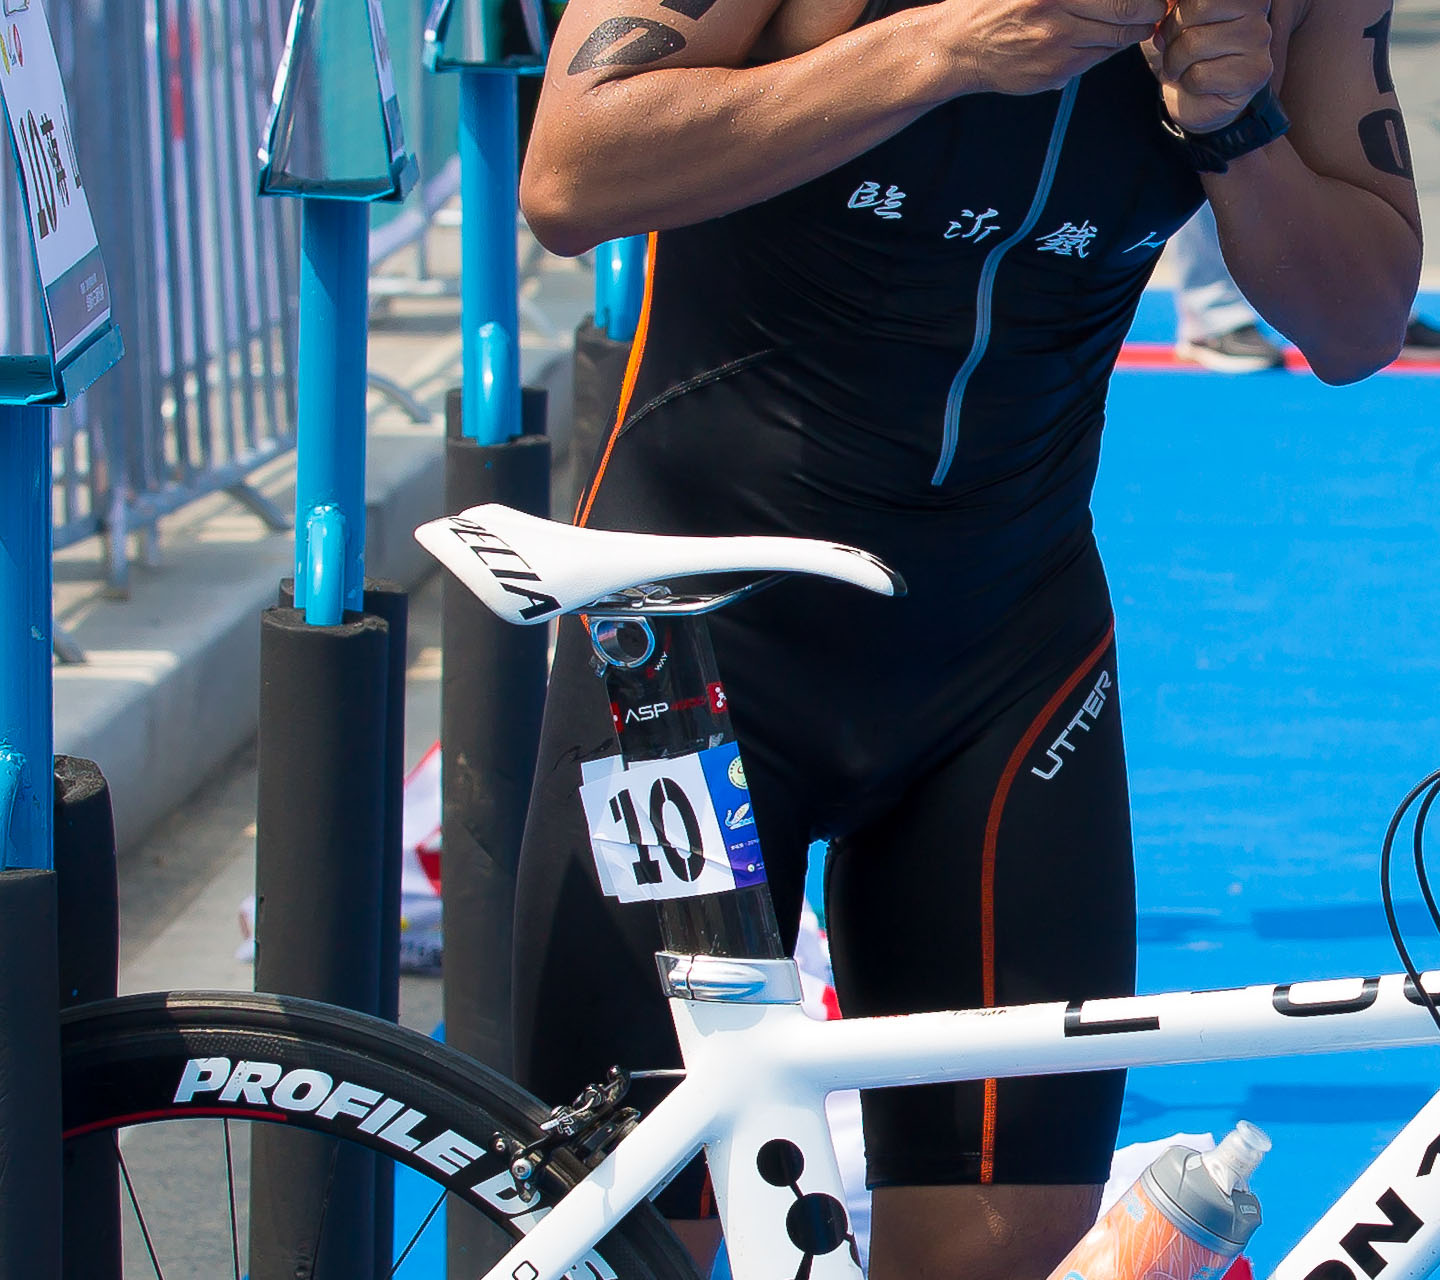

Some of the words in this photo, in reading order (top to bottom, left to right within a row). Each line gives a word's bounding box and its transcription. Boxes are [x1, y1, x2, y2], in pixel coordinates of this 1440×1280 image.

[1030, 670, 1112, 780] UTTER
[608, 777, 706, 886] 10
[173, 1057, 487, 1176] PROFILE
